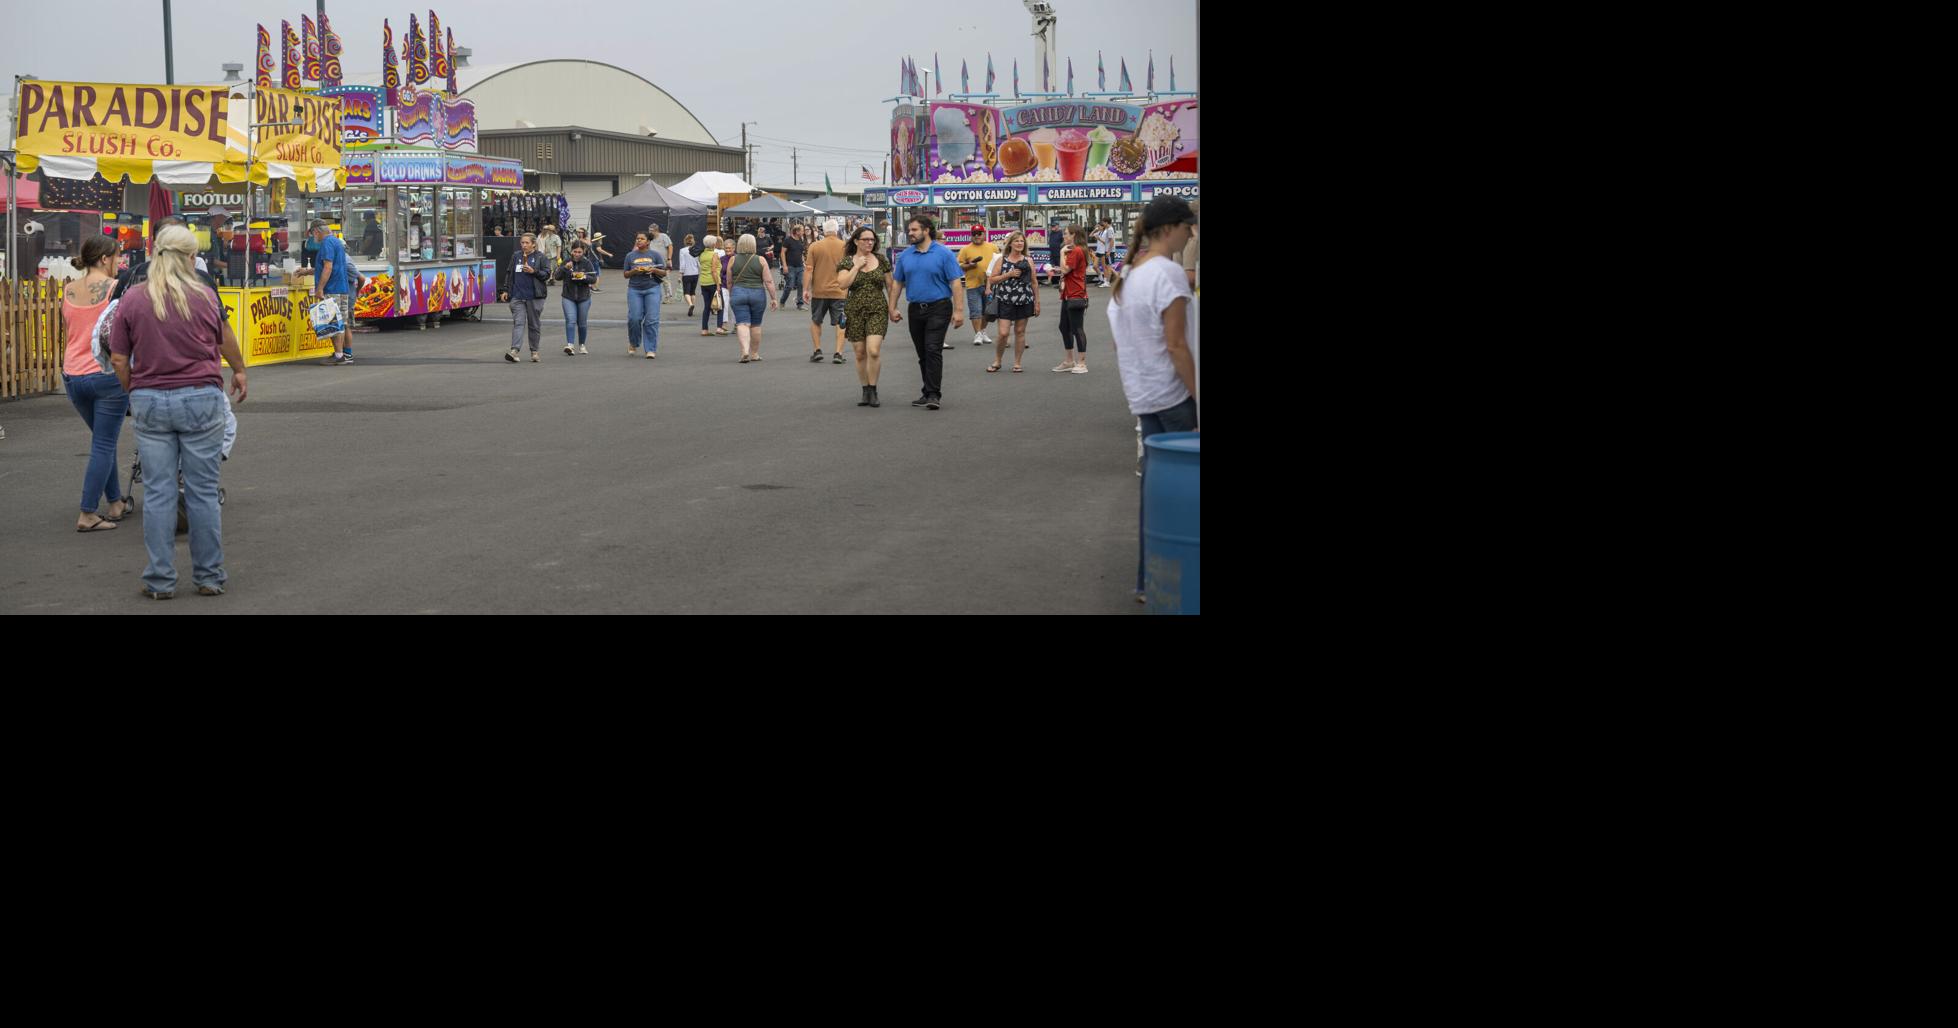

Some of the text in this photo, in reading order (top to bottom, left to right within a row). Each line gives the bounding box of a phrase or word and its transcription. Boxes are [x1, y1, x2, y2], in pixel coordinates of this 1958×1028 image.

[19, 84, 229, 144] PARADISE
[343, 98, 372, 121] ARS
[1017, 105, 1127, 124] CANDY LAND
[256, 89, 341, 153] PARADISE
[62, 132, 182, 158] SLUSH Co.
[276, 143, 308, 162] SLUSH
[346, 164, 373, 178] OS
[381, 162, 406, 180] COLD
[408, 162, 442, 180] DRINKS
[183, 193, 244, 207] FOOTLO
[944, 189, 1017, 200] COTTON CANDY
[1048, 188, 1122, 199] CARAMEL APPLES
[250, 295, 294, 324] PARADISE
[260, 321, 277, 335] Slush
